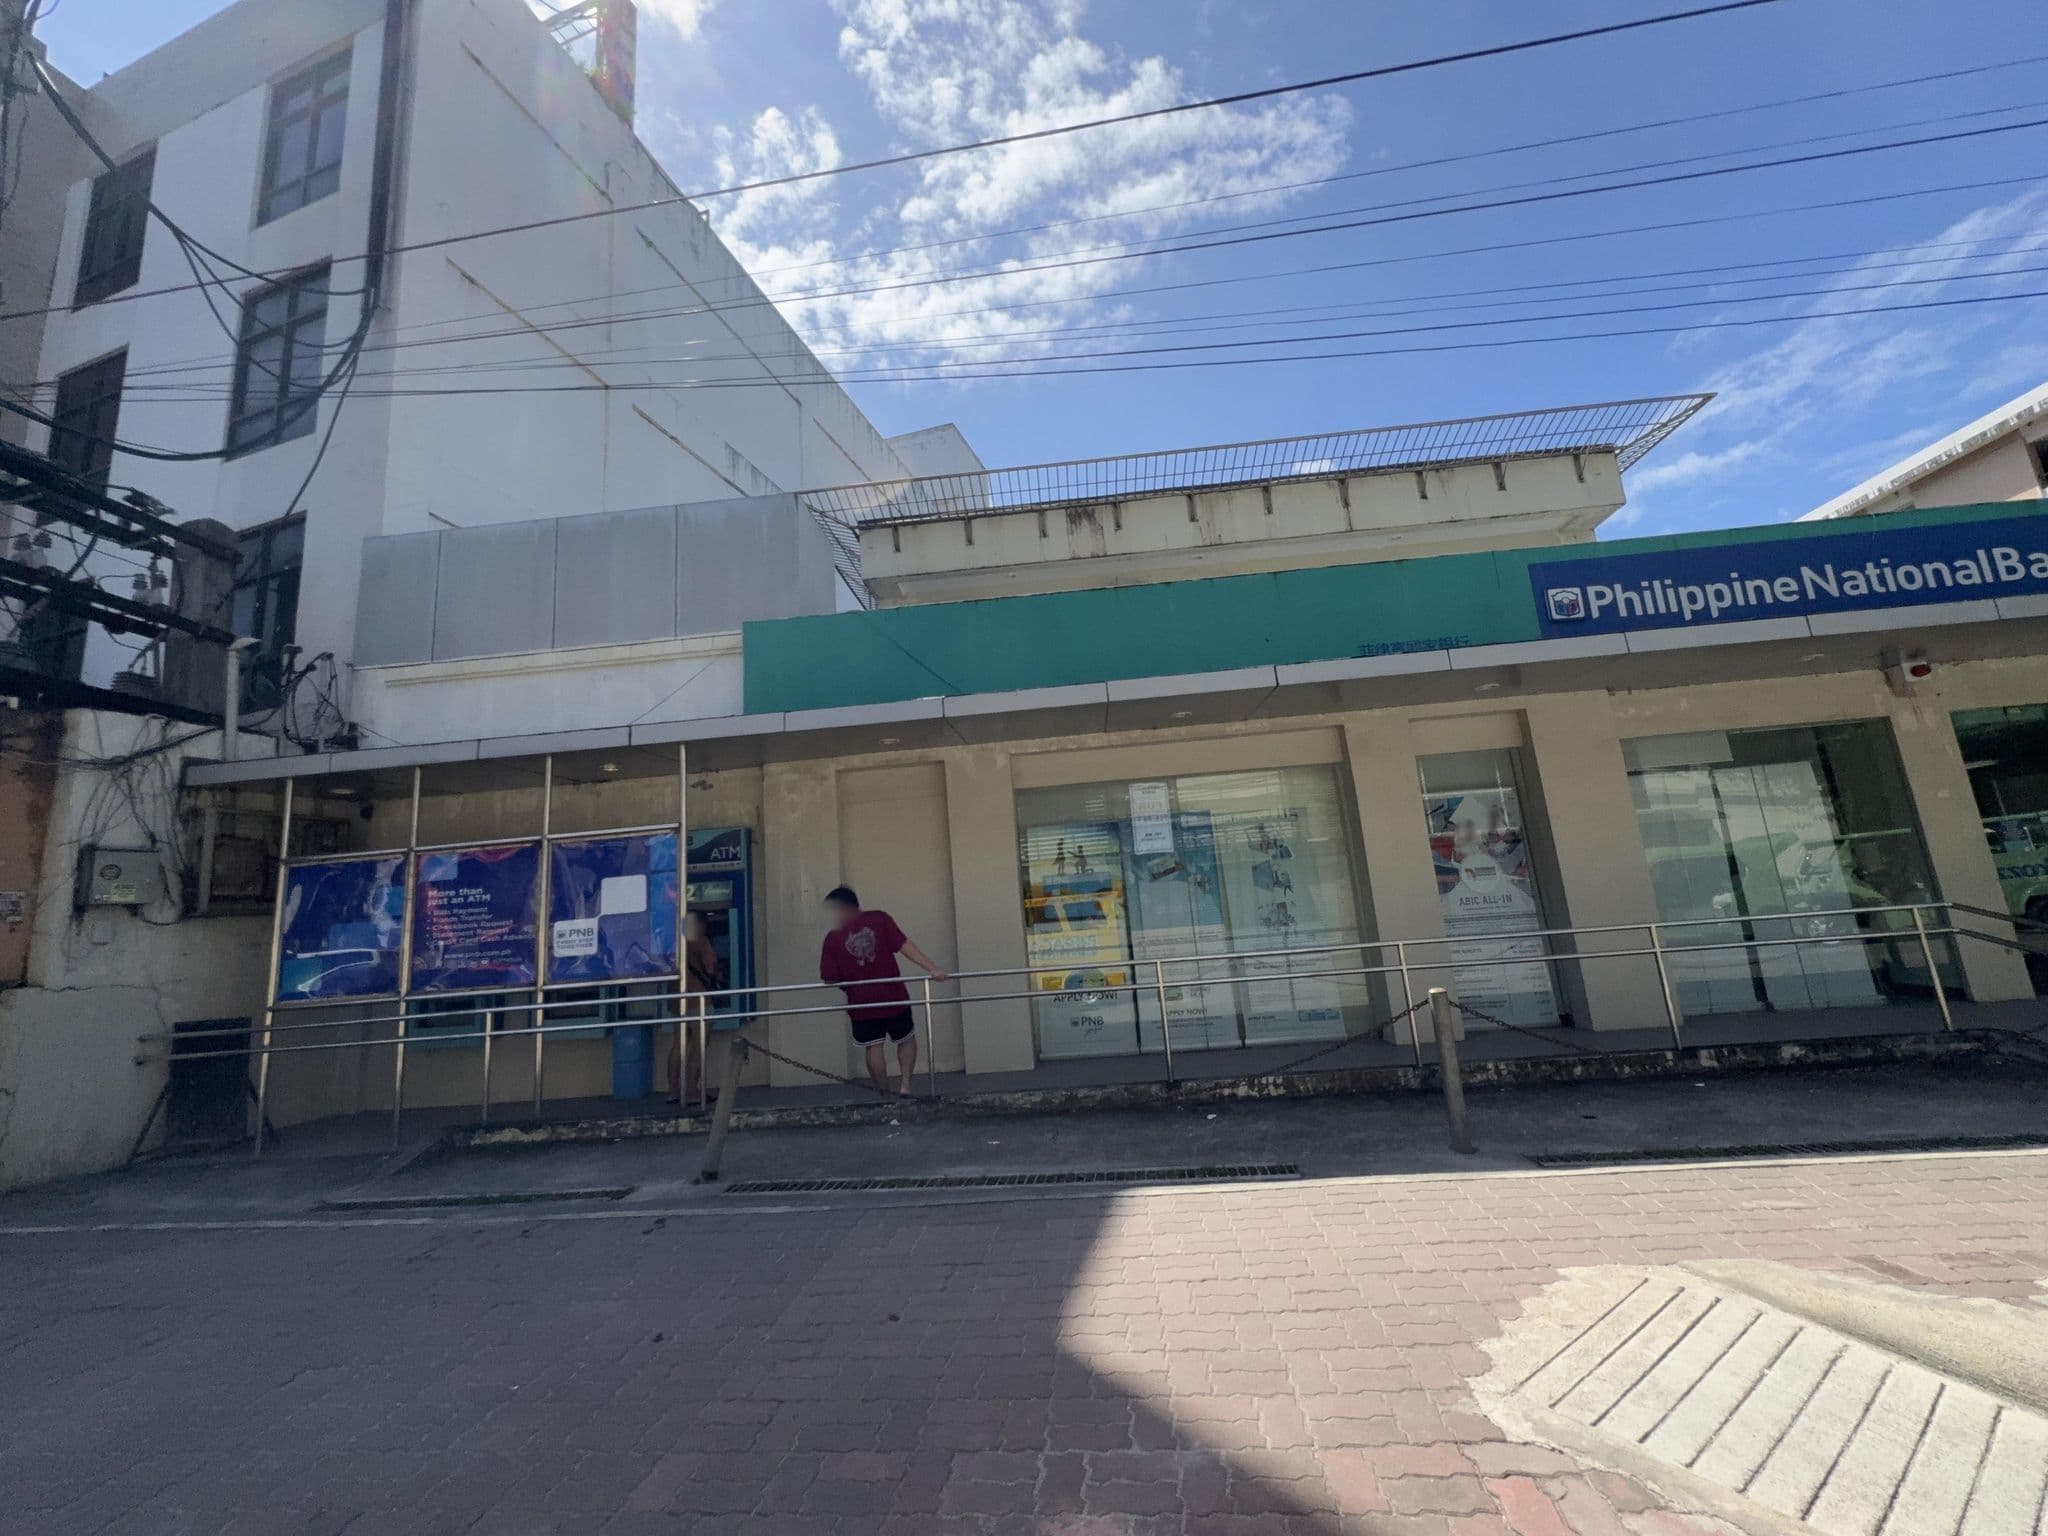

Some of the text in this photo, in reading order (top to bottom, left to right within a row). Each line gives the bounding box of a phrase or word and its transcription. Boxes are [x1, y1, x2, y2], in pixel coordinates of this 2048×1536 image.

[710, 846, 742, 861] ATM
[427, 889, 457, 898] More
[1483, 893, 1513, 905] ALL-IN
[427, 894, 491, 907] just an ATM
[569, 927, 594, 937] PNB
[1081, 1016, 1104, 1026] PNB
